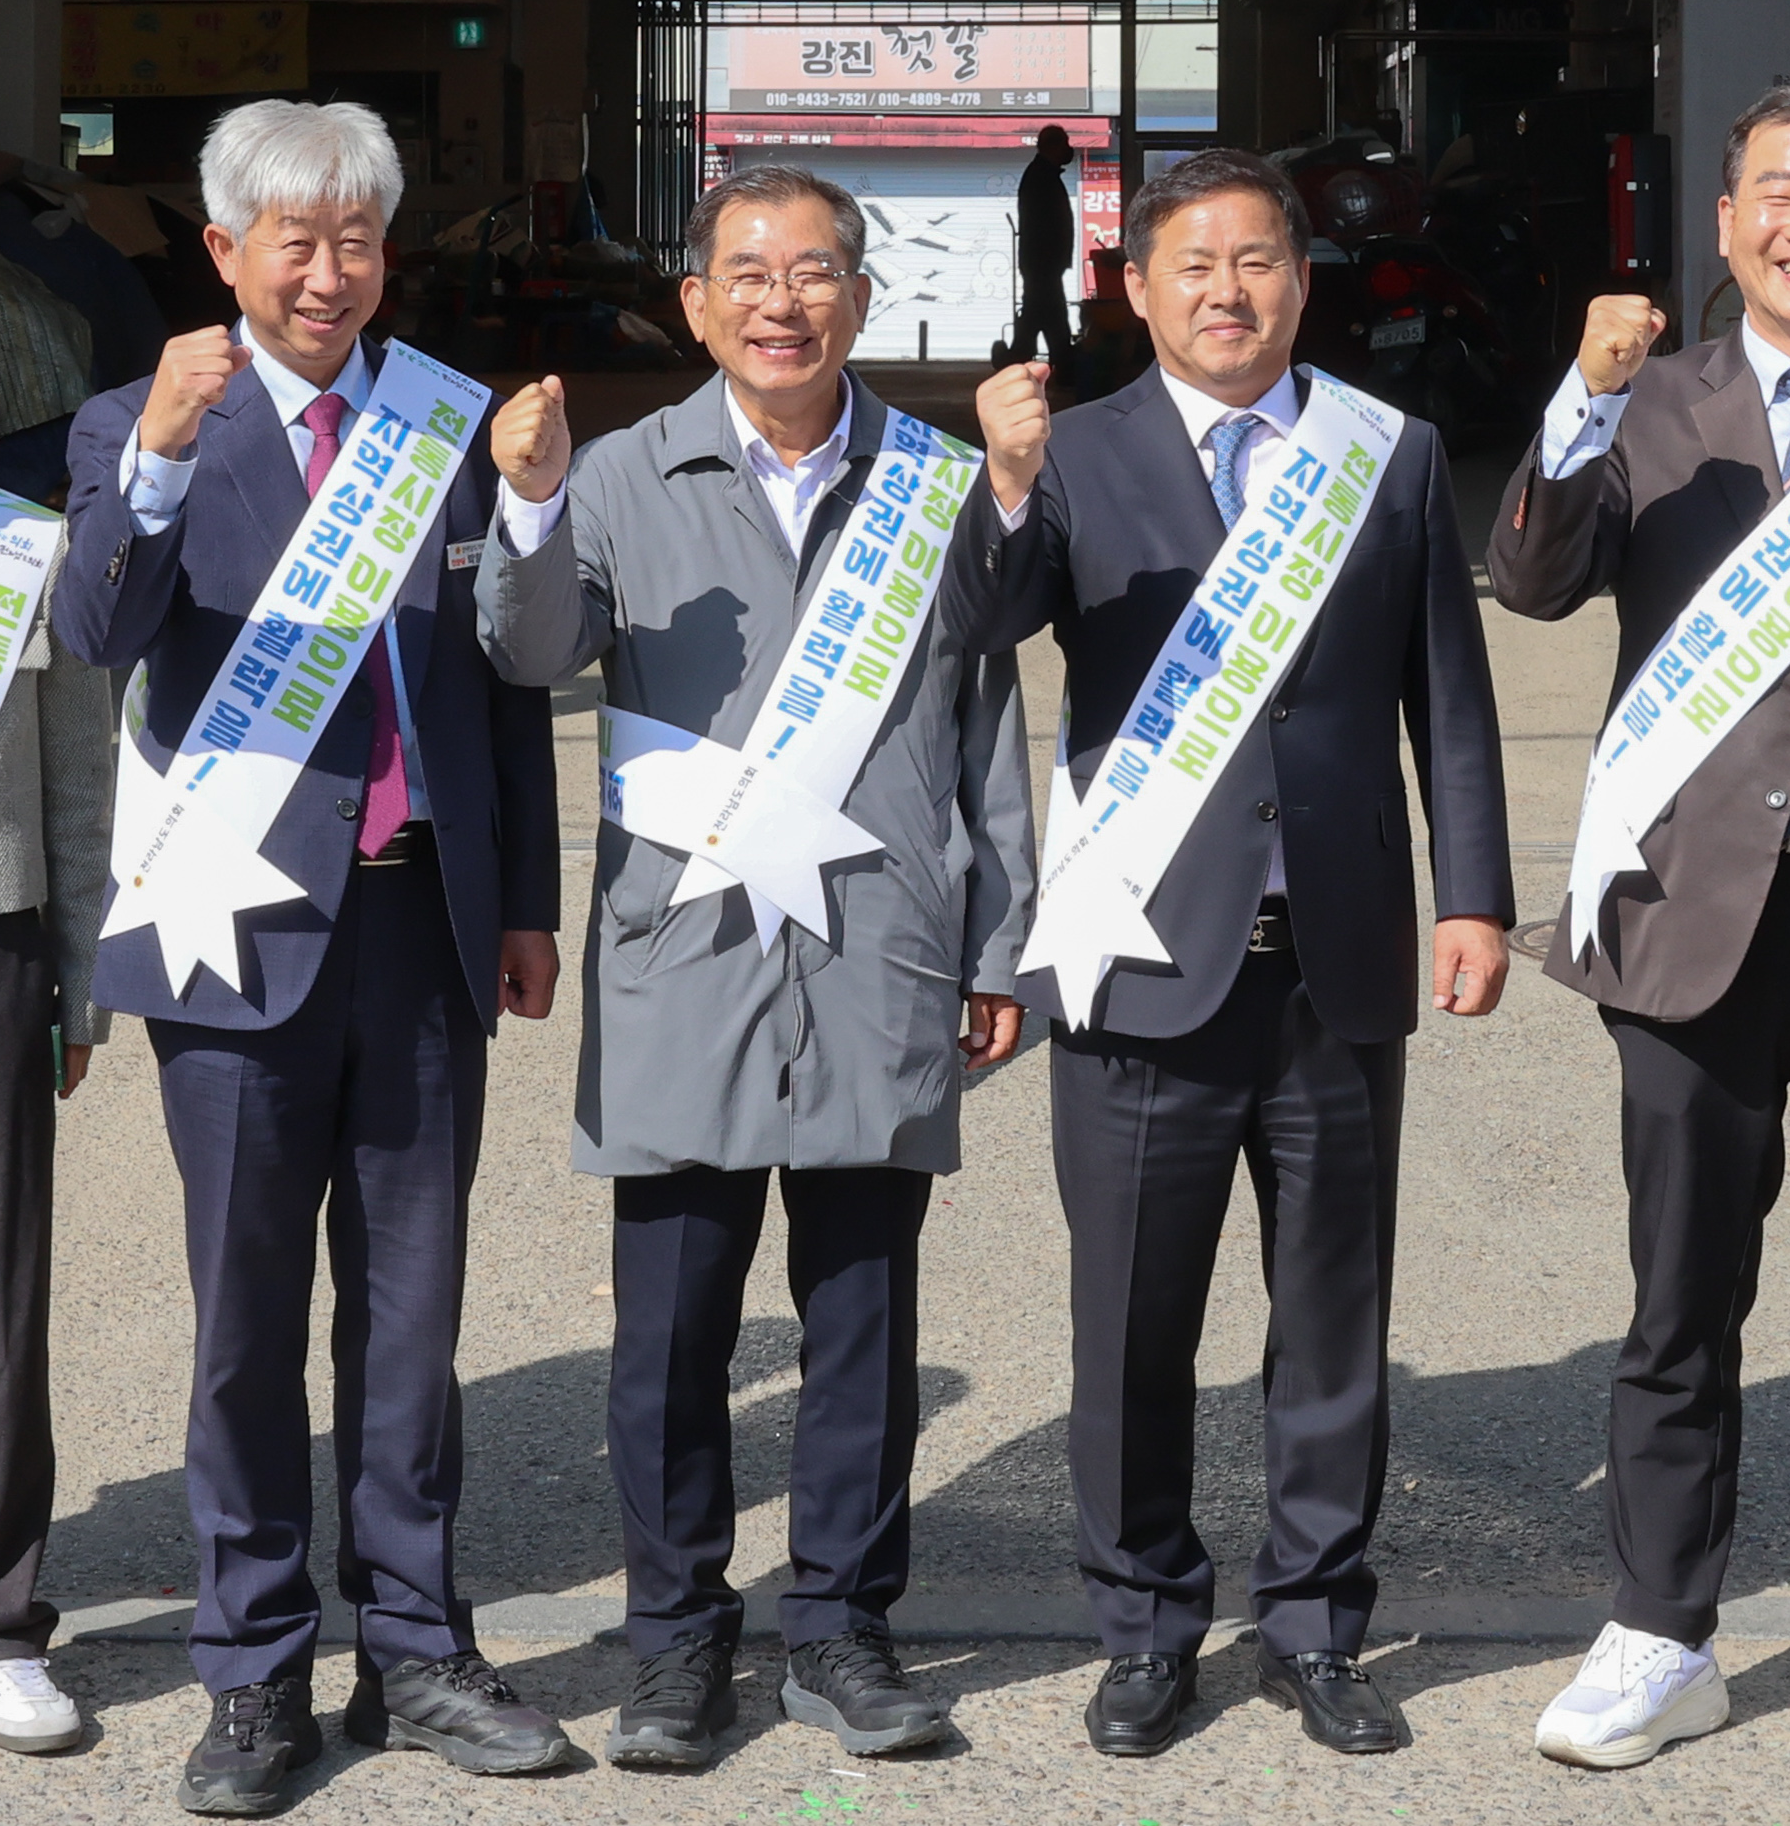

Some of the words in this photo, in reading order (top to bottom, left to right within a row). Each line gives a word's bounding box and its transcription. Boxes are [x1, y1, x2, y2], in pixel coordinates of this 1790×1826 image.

[766, 92, 867, 107] 010-9433-7521
[878, 92, 981, 107] 010-4809-4778
[802, 40, 874, 76] 강진
[281, 402, 414, 611] 지역상권에
[372, 397, 469, 553] 전통시장
[841, 414, 933, 588] 지역상권에
[1181, 445, 1328, 663] 지역상권에
[1277, 439, 1379, 602] 전통시장
[184, 607, 305, 792] 활력을!
[270, 551, 393, 735] 이용으로
[765, 586, 867, 762] 활력을!
[842, 529, 942, 702] 이용으로
[1168, 600, 1300, 782] 이용으로
[1605, 611, 1728, 770] 활력을!
[713, 766, 760, 832] 전라남도의회
[1091, 656, 1203, 834] 활력을!
